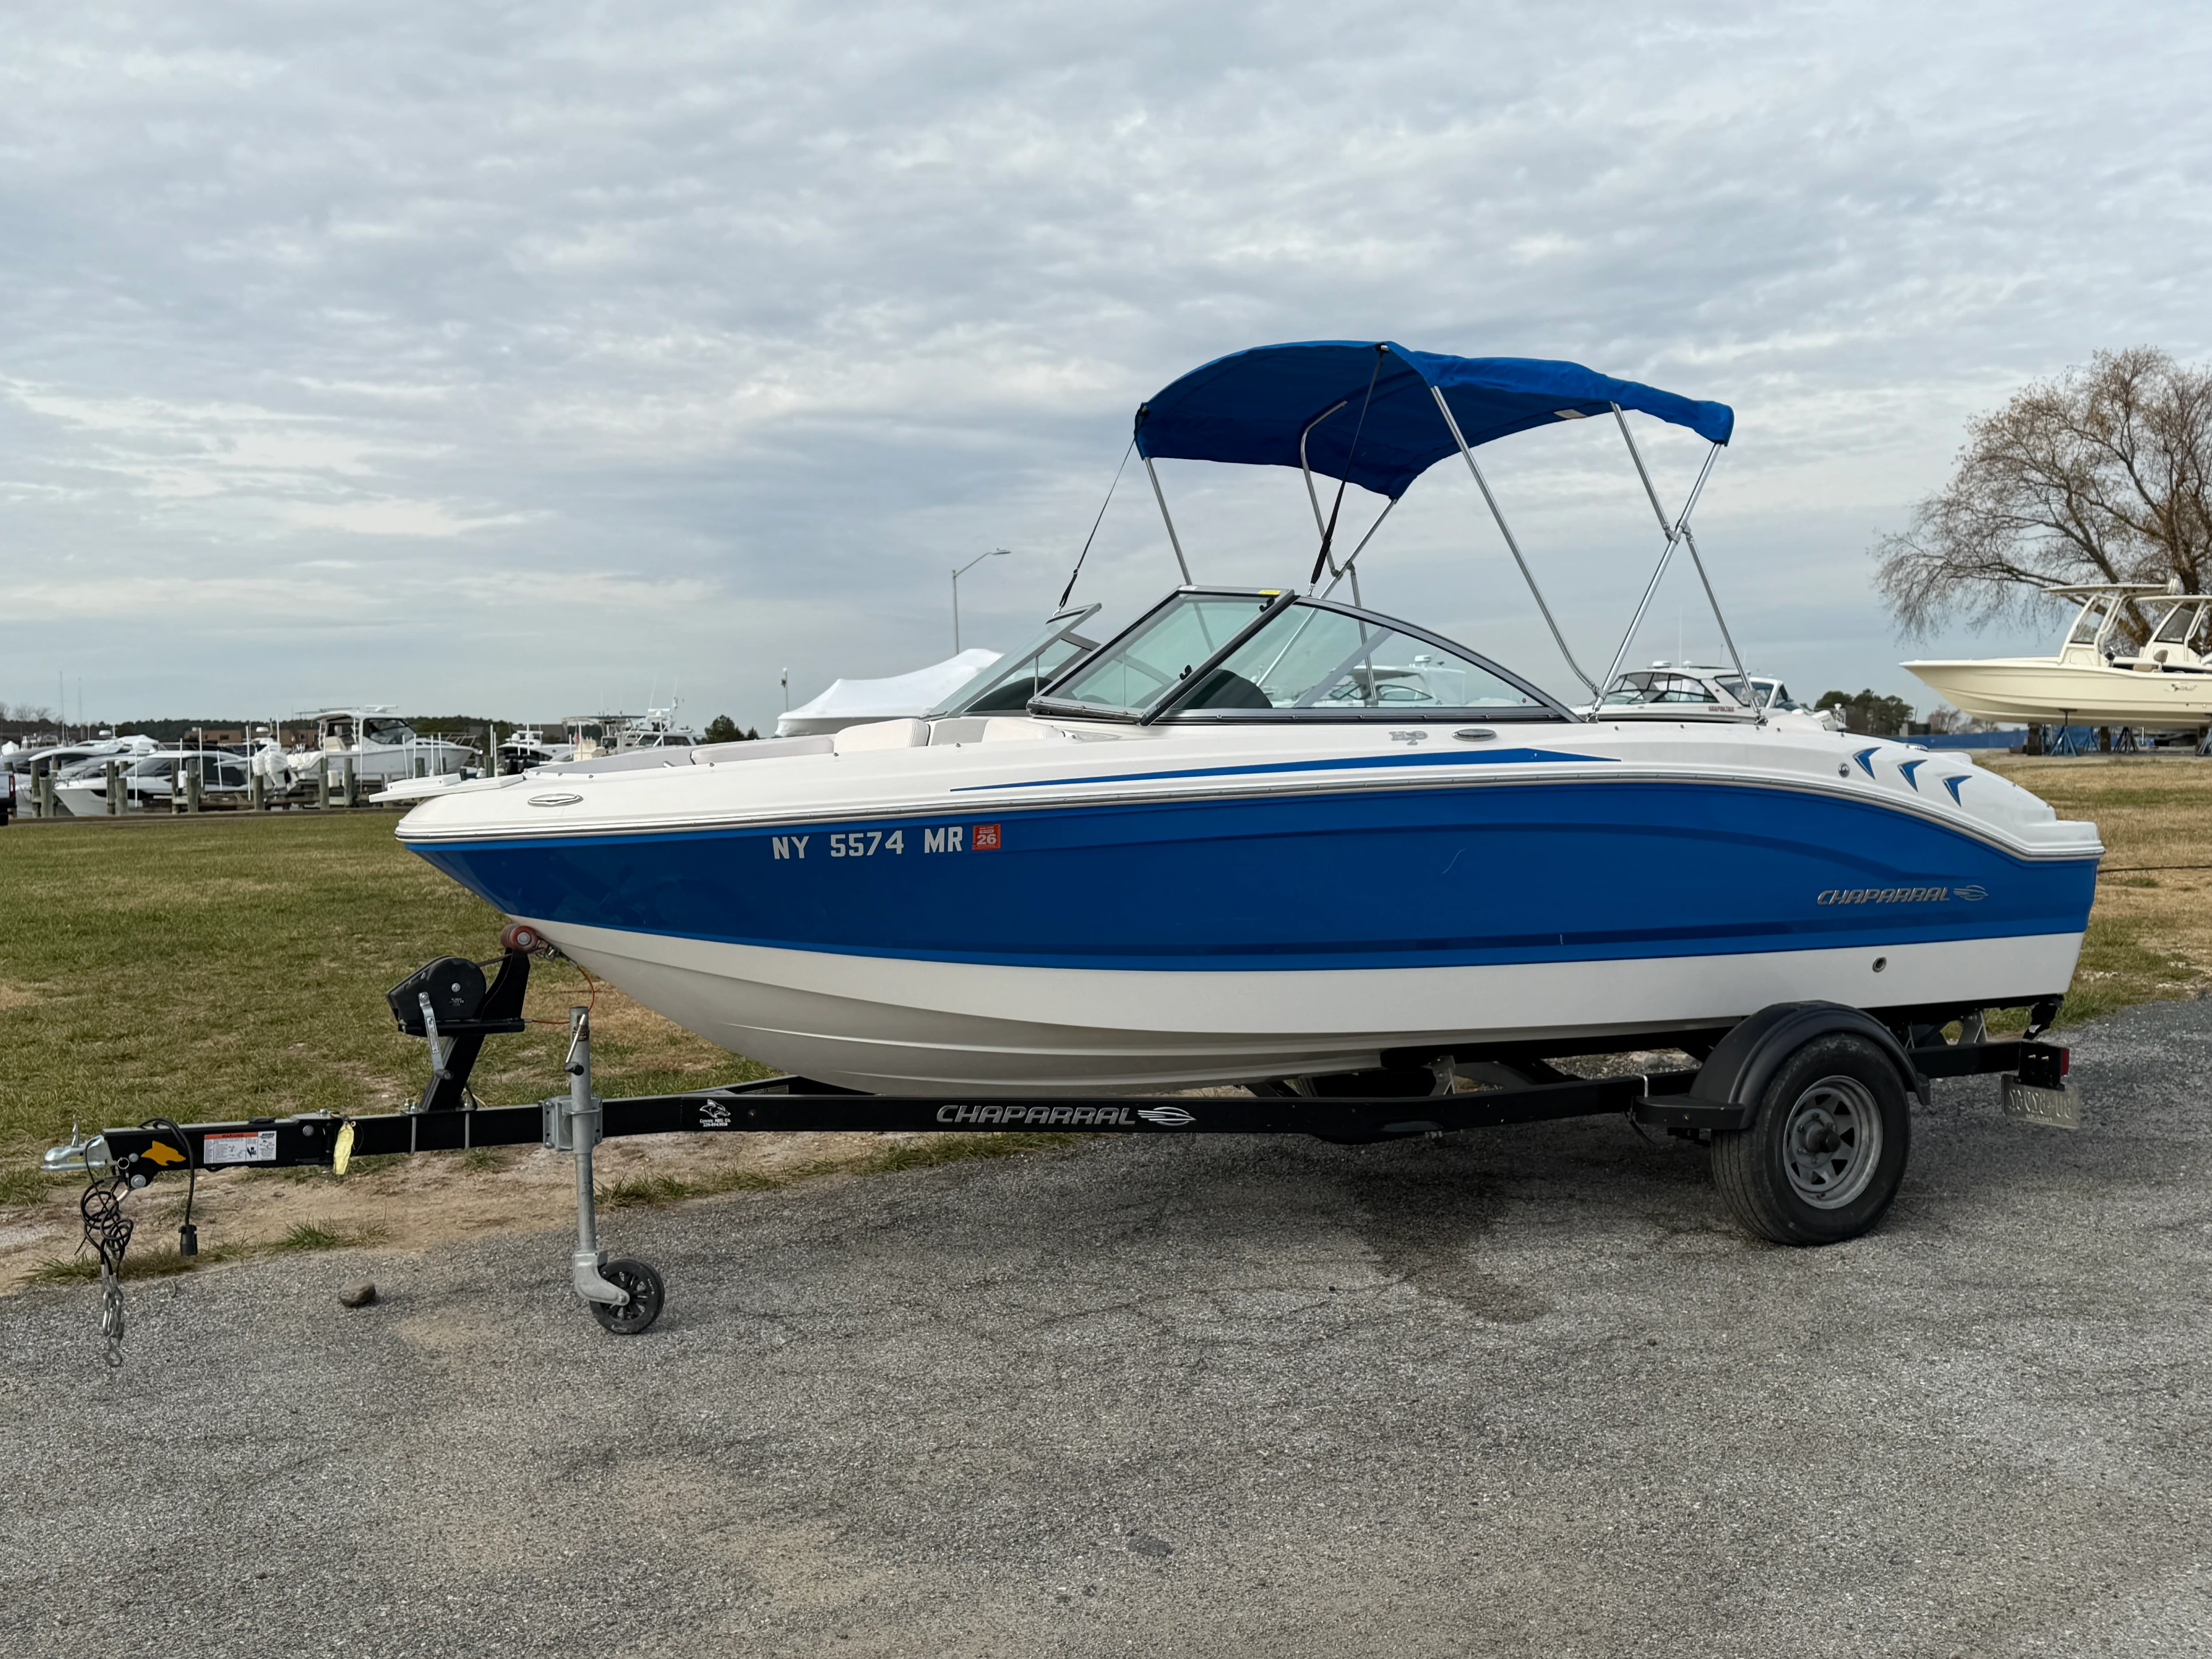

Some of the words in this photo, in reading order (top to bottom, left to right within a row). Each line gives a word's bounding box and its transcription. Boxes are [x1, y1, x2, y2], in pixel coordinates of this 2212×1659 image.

[772, 836, 809, 859] NY
[831, 830, 904, 857] 5574
[924, 826, 963, 853] MR
[976, 833, 997, 845] 26
[1817, 887, 1950, 905] CHAPARRAL
[937, 1105, 1135, 1125] CHAPARRAL
